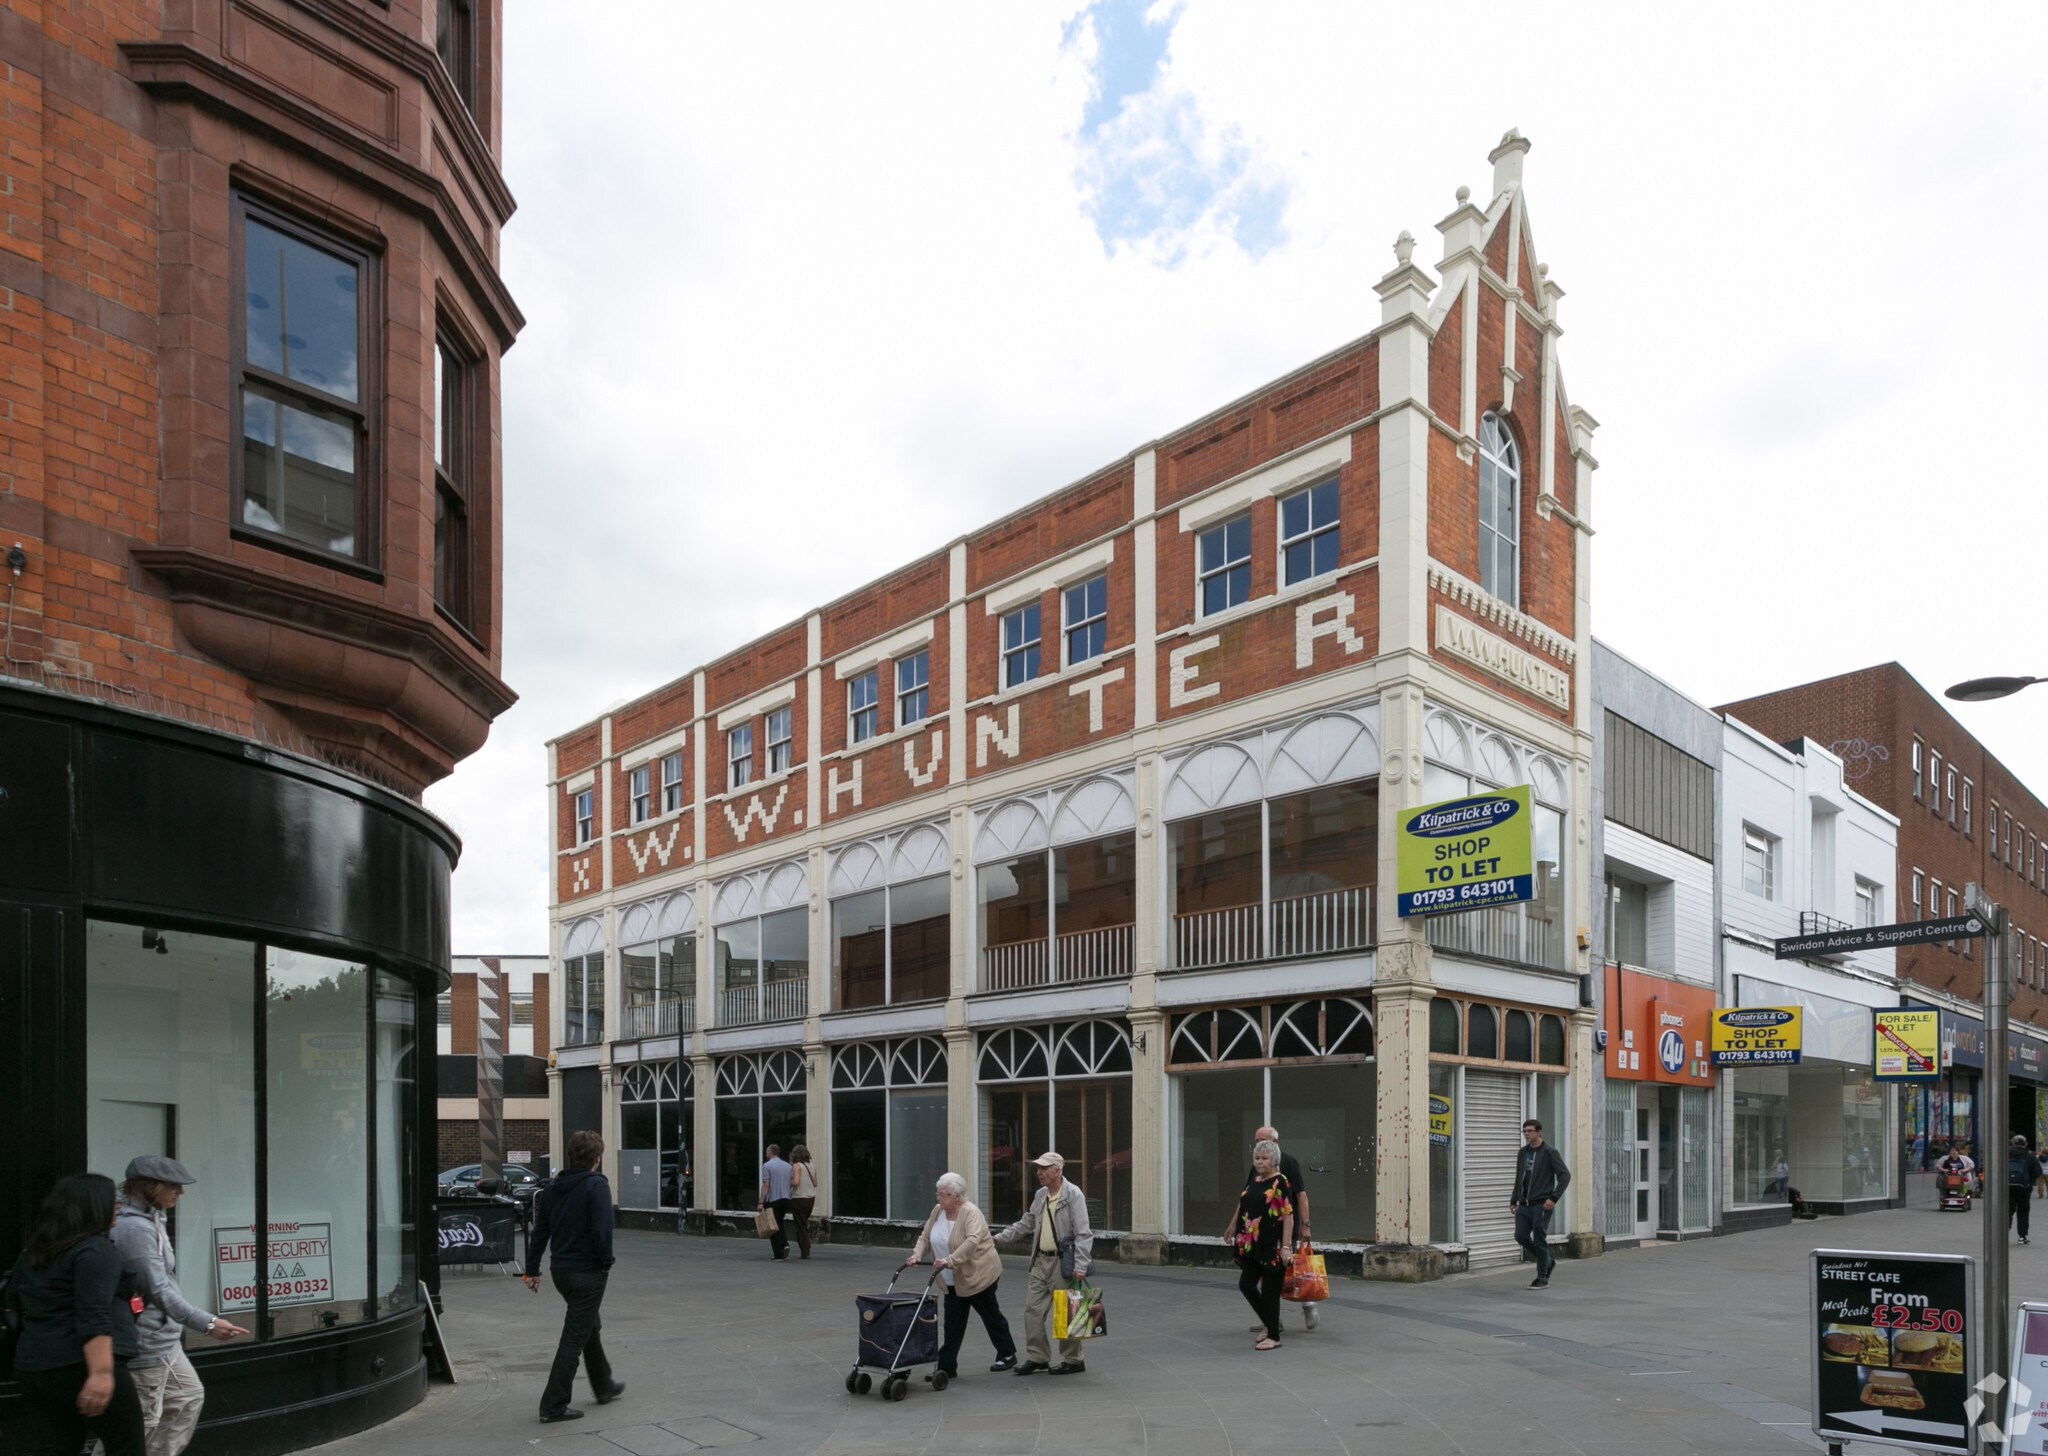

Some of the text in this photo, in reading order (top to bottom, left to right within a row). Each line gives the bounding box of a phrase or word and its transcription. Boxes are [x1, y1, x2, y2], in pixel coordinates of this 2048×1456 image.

[1418, 801, 1510, 829] Kilpatrick & Co
[1434, 837, 1491, 861] SHOP
[1425, 857, 1501, 884] TO LET
[1412, 879, 1515, 906] 01793 643101
[1409, 892, 1519, 914] www.kilpatrick-cpc.co.uk
[1780, 923, 1966, 953] Swindon Advice & Support Centre
[1727, 1012, 1768, 1023] Kilpatrick
[1879, 1015, 1901, 1023] FOR
[1733, 1028, 1778, 1039] SHOP
[1896, 1023, 1916, 1032] LET
[1724, 1039, 1788, 1049] TO LET
[1719, 1050, 1793, 1061] 01793 643101
[1430, 1119, 1447, 1131] LET
[249, 1222, 300, 1233] WRNING
[1821, 1269, 1901, 1284] STREET CAFE
[294, 1278, 329, 1294] 0332
[1821, 1298, 1849, 1311] Meal
[1870, 1288, 1929, 1307] From
[1839, 1305, 1870, 1318] Deals
[1871, 1304, 1964, 1334] £2.50
